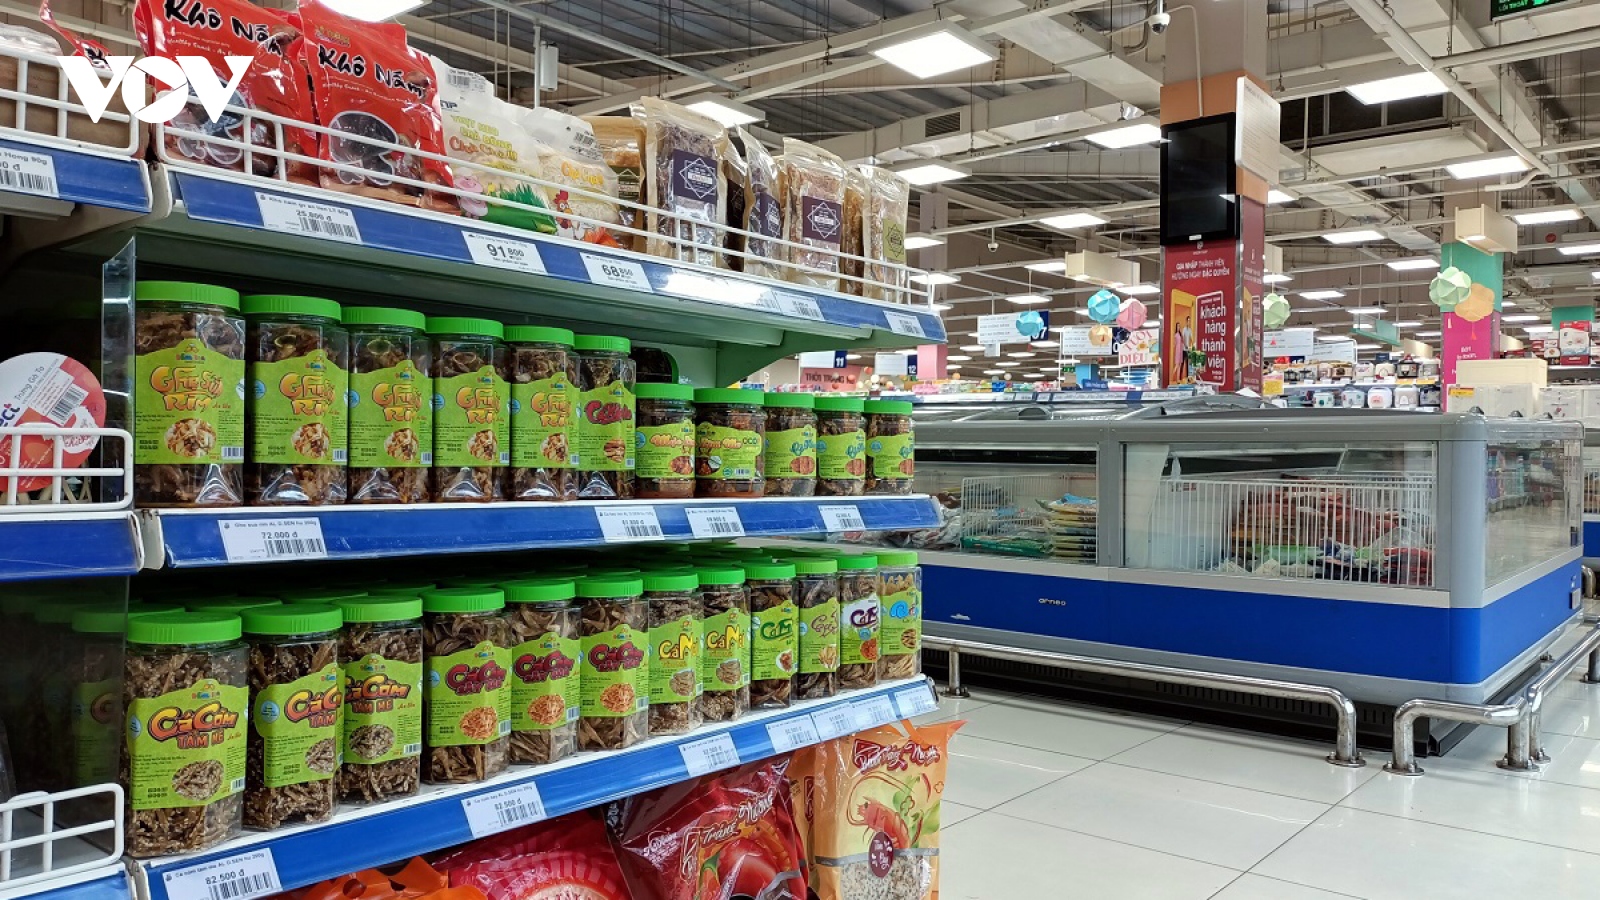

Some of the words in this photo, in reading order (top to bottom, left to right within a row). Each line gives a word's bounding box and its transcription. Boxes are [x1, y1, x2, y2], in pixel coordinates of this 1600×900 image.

[318, 43, 365, 77] Khô
[374, 62, 425, 98] Nấm
[487, 243, 506, 257] 91
[601, 264, 620, 277] 68
[1200, 304, 1226, 319] khách
[1205, 320, 1226, 336] hàng
[1201, 337, 1226, 352] thành
[835, 358, 844, 367] 11
[1207, 354, 1225, 368] viên
[908, 365, 916, 374] 12
[261, 531, 290, 539] 72.000
[205, 871, 236, 885] 82.500
